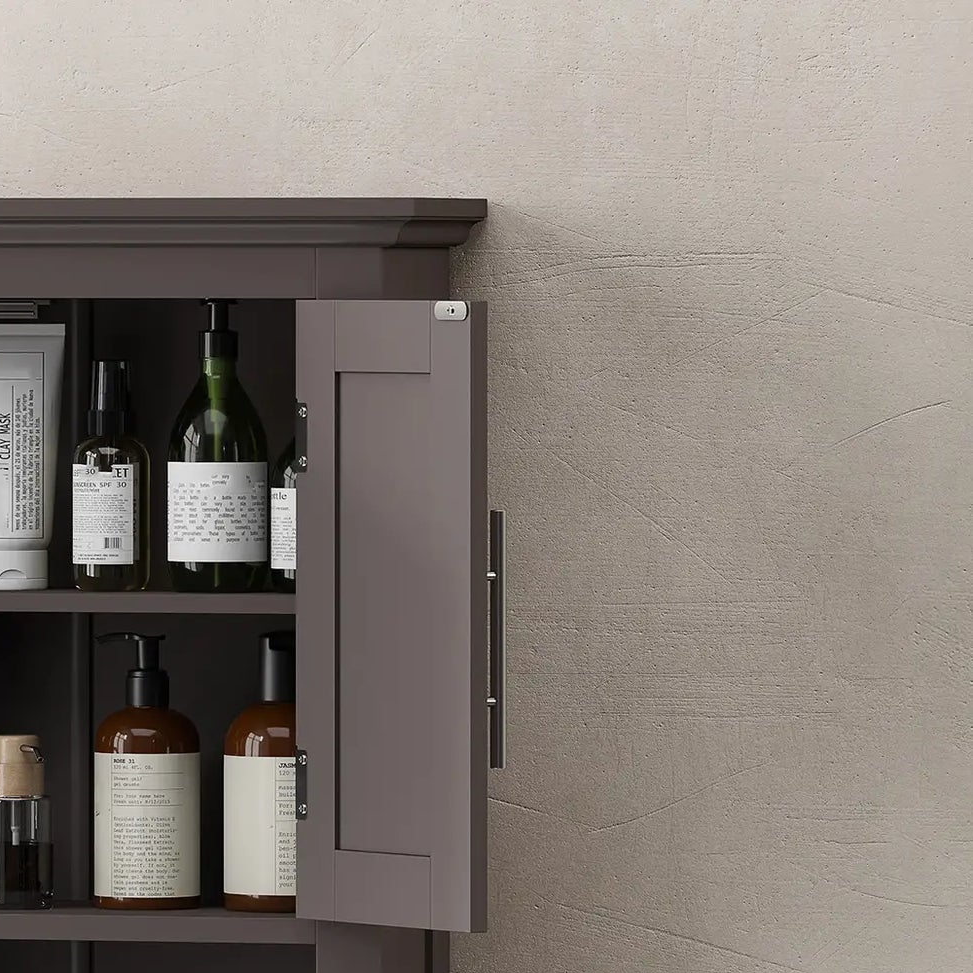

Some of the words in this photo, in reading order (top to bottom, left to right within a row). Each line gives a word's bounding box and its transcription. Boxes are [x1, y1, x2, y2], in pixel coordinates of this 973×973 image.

[0, 413, 10, 434] MASK
[0, 439, 10, 460] CLAY
[114, 468, 129, 478] ET
